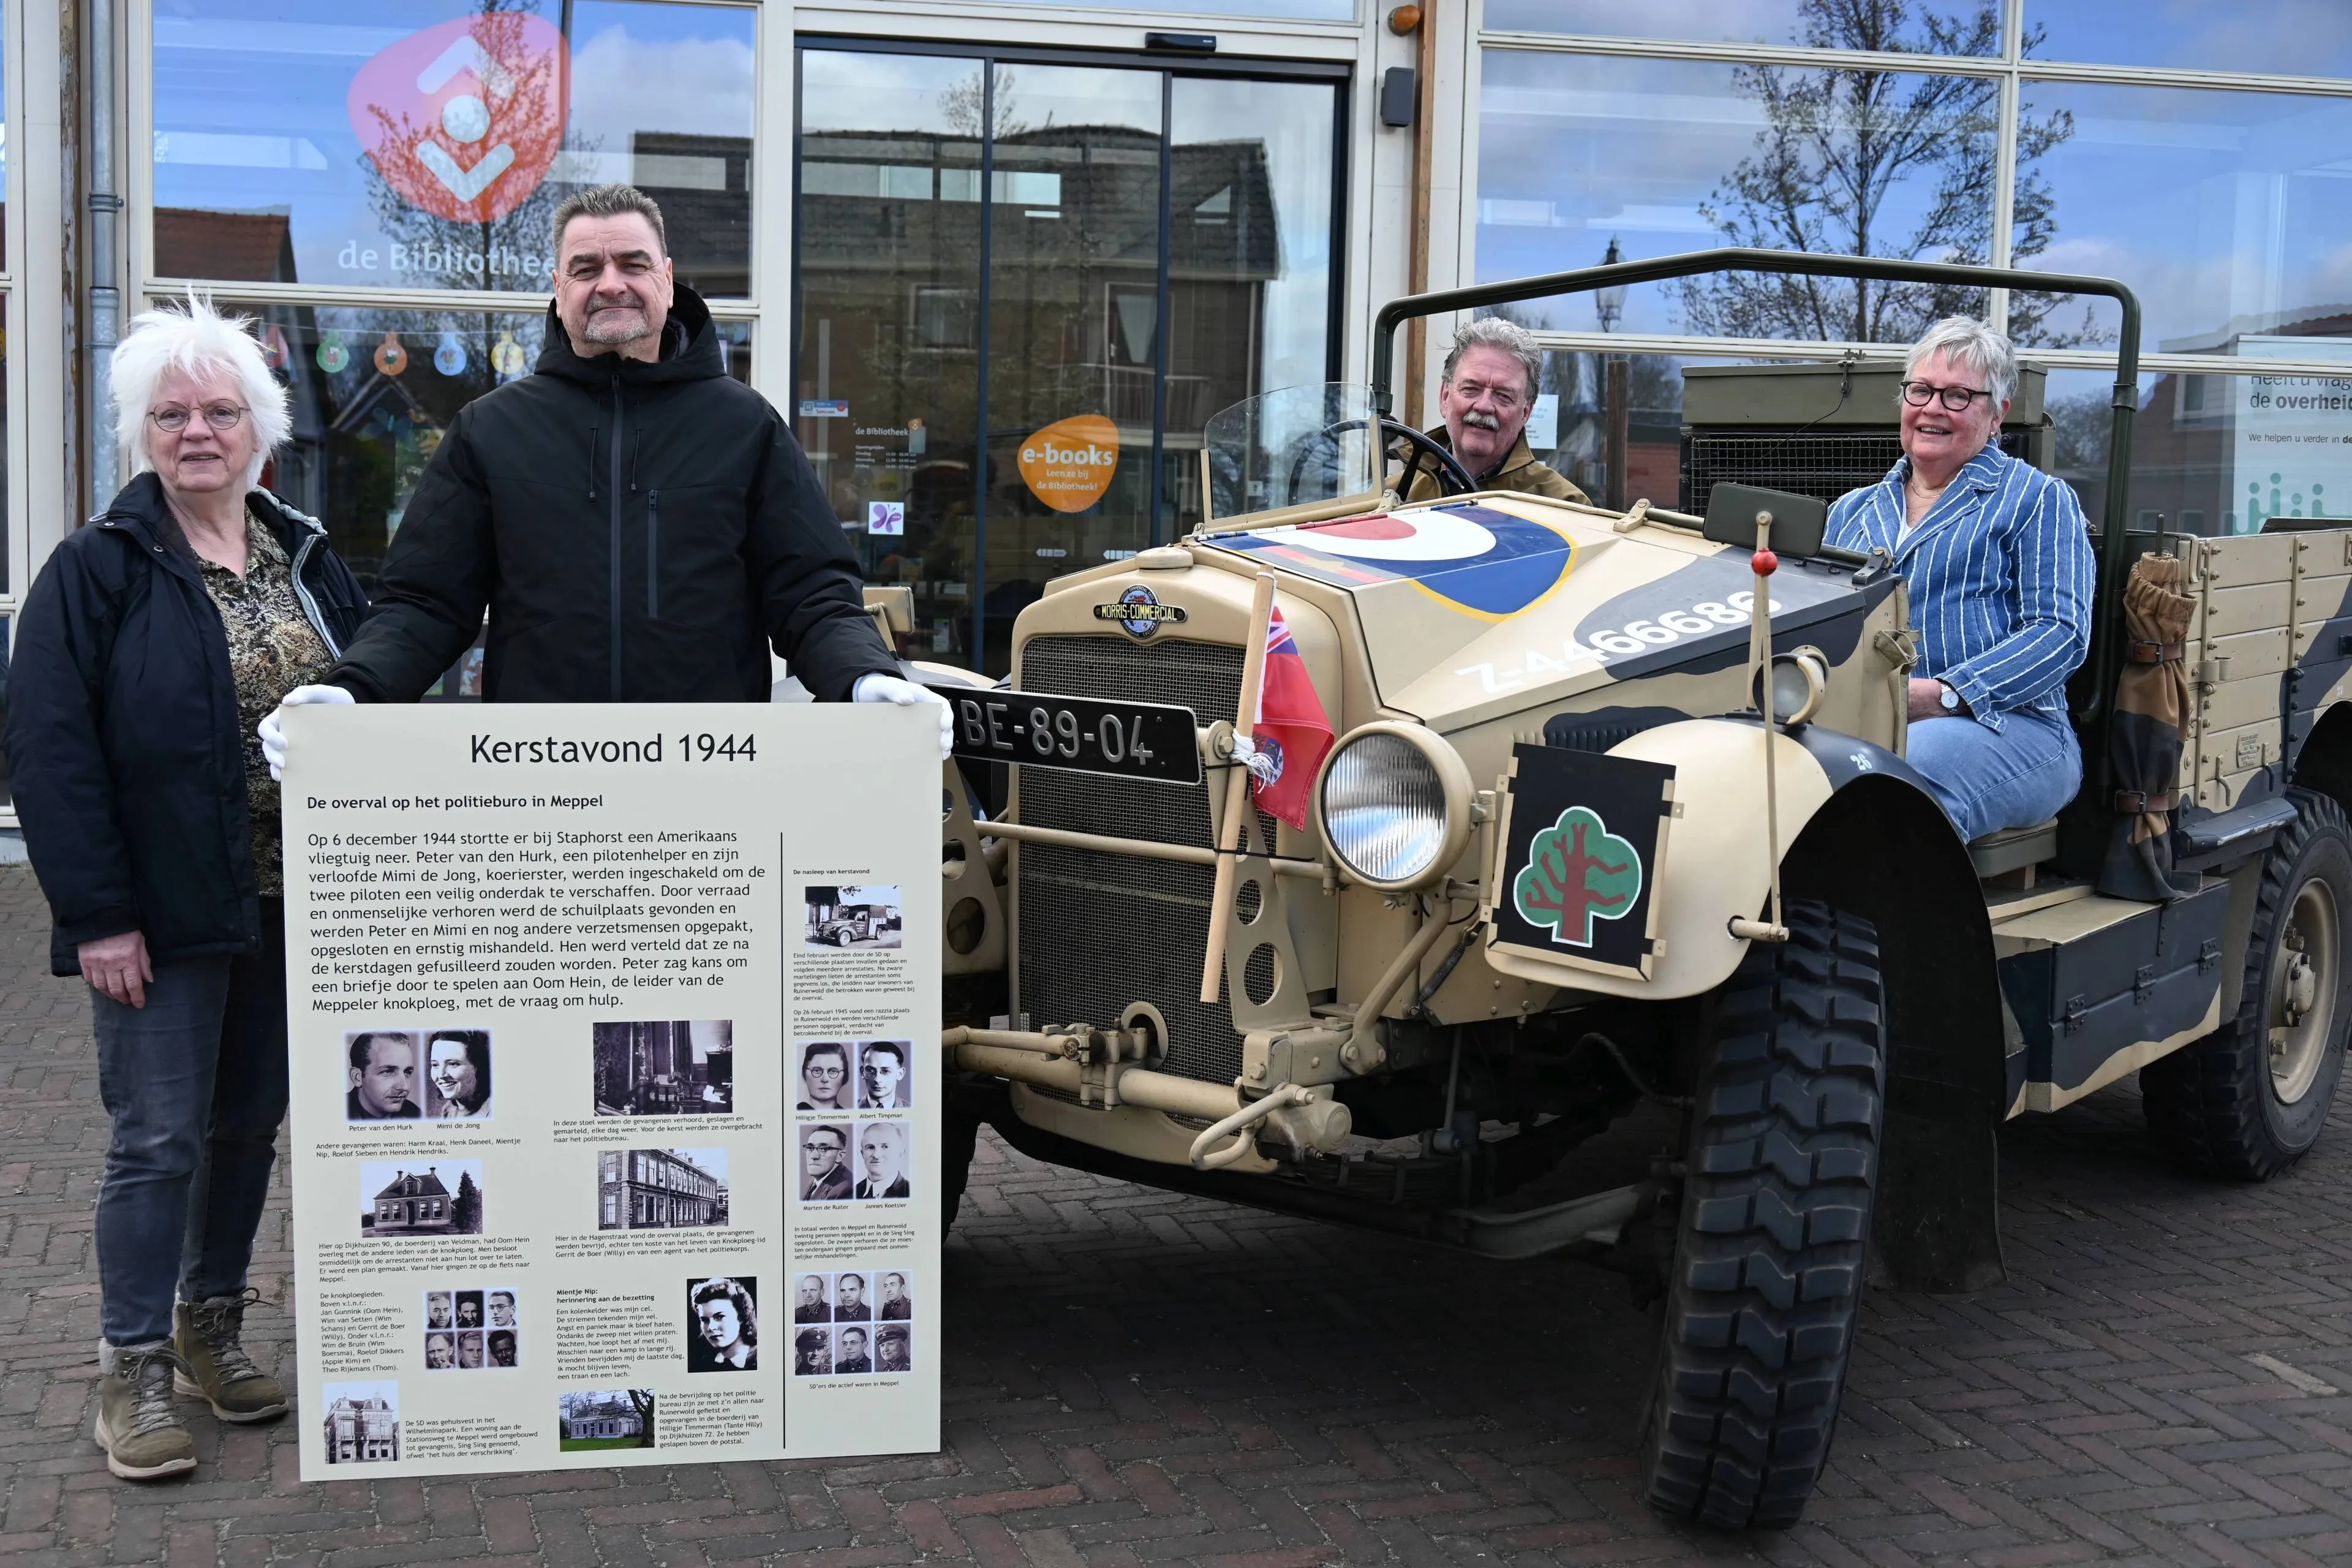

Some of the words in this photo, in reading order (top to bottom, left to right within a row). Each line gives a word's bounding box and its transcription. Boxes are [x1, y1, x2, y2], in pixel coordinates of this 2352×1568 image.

[338, 239, 378, 270] de
[2301, 377, 2310, 386] u
[2317, 379, 2352, 391] vrag
[2250, 392, 2271, 408] de
[867, 427, 909, 435] Bibliotheek
[2264, 434, 2292, 443] helpen
[2304, 434, 2329, 443] verder
[1022, 443, 1113, 466] e-books
[1078, 470, 1089, 480] bij
[1036, 481, 1047, 489] de
[1049, 481, 1098, 491] Bibliotheek!
[1102, 603, 1178, 621] MORRIS-COMMERCIAL
[1454, 590, 1782, 695] Z-4466686
[959, 699, 1154, 766] BE-89-04
[472, 733, 662, 763] Kerstavond
[679, 733, 756, 762] 1944
[1850, 753, 1873, 771] 26
[307, 797, 326, 809] De
[332, 796, 386, 809] overval
[392, 799, 410, 811] op
[416, 796, 440, 808] het
[445, 795, 527, 810] politieburo
[532, 795, 545, 807] in
[551, 794, 603, 810] Meppel
[308, 834, 328, 848] Op
[333, 834, 341, 845] 6
[346, 833, 417, 845] december
[423, 833, 456, 845] 1944
[461, 833, 508, 844] stortte
[514, 835, 529, 843] er
[534, 832, 551, 846] bij
[557, 831, 623, 846] Staphorst
[628, 834, 653, 842] een
[657, 830, 737, 842] Amerikaans
[309, 852, 370, 867] vliegtuig
[376, 854, 409, 863] neer.
[417, 851, 454, 863] Peter
[459, 854, 483, 862] van
[489, 850, 514, 862] den
[520, 850, 556, 864] Hurk,
[563, 853, 587, 861] een
[594, 849, 687, 864] pilotenhelper
[692, 851, 707, 860] en
[713, 848, 738, 862] zijn
[309, 870, 377, 883] verloofde
[382, 870, 415, 881] Mimi
[421, 869, 438, 881] de
[443, 869, 480, 884] Jong,
[487, 869, 566, 882] koerierster,
[572, 867, 624, 880] werden
[629, 866, 717, 881] ingeschakeld
[723, 869, 743, 878] om
[748, 865, 765, 877] de
[310, 891, 345, 901] twee
[351, 889, 400, 903] piloten
[405, 891, 431, 900] een
[436, 888, 474, 902] veilig
[480, 886, 545, 899] onderdak
[550, 888, 564, 898] te
[569, 885, 654, 897] verschaffen.
[662, 885, 693, 896] Door
[698, 884, 749, 896] verraad
[310, 910, 326, 919] en
[333, 906, 427, 921] onmenselijke
[432, 906, 494, 918] verhoren
[500, 905, 534, 916] werd
[540, 904, 557, 916] de
[562, 903, 644, 918] schuilplaats
[649, 902, 714, 918] gevonden
[720, 905, 736, 914] en
[311, 925, 363, 938] werden
[369, 925, 407, 937] Peter
[412, 927, 428, 936] en
[434, 924, 466, 936] Mimi
[472, 927, 488, 935] en
[494, 926, 518, 938] nog
[524, 922, 571, 935] andere
[577, 922, 679, 933] verzetsmensen
[685, 920, 752, 935] opgepakt,
[316, 1151, 330, 1159] Nip,
[330, 1291, 385, 1300] knokploegleden.
[556, 1288, 583, 1297] Mientje
[659, 1441, 688, 1449] geslapen
[720, 1438, 744, 1447] potstal.
